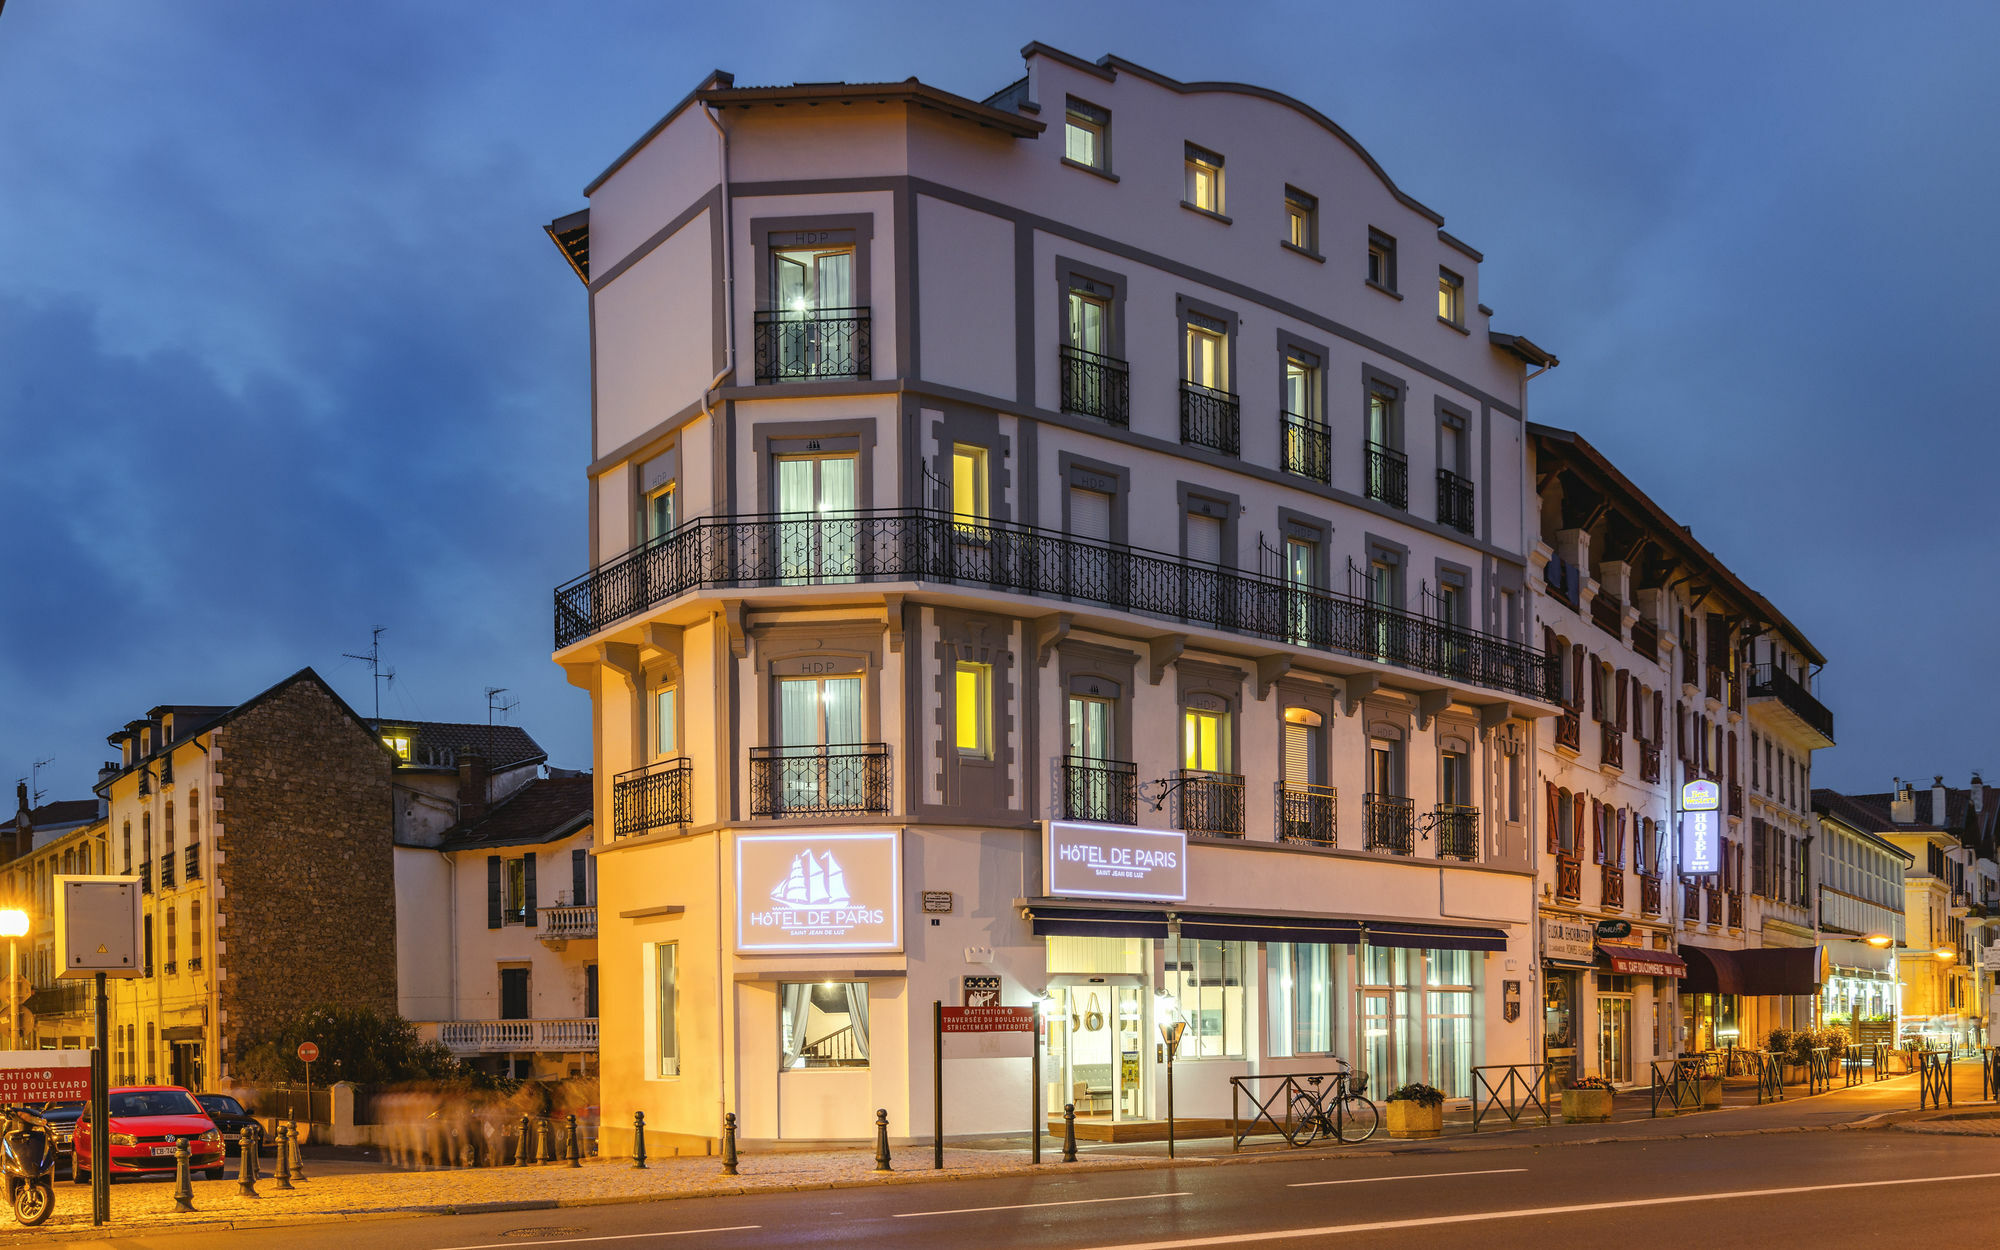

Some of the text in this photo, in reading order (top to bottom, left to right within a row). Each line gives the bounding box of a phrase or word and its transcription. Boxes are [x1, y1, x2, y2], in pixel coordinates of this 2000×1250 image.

[795, 231, 828, 244] HDP
[1081, 476, 1105, 489] HDP
[802, 662, 835, 674] HDP
[1691, 790, 1709, 799] Best
[1686, 797, 1716, 805] Western
[1694, 813, 1707, 860] HOTEL
[1111, 847, 1132, 865] DE
[1135, 849, 1177, 868] PARIS
[807, 911, 831, 925] DE
[835, 909, 884, 925] PARIS
[3, 1080, 88, 1091] DU BOULEVARD
[23, 1090, 82, 1100] INTERDITE
